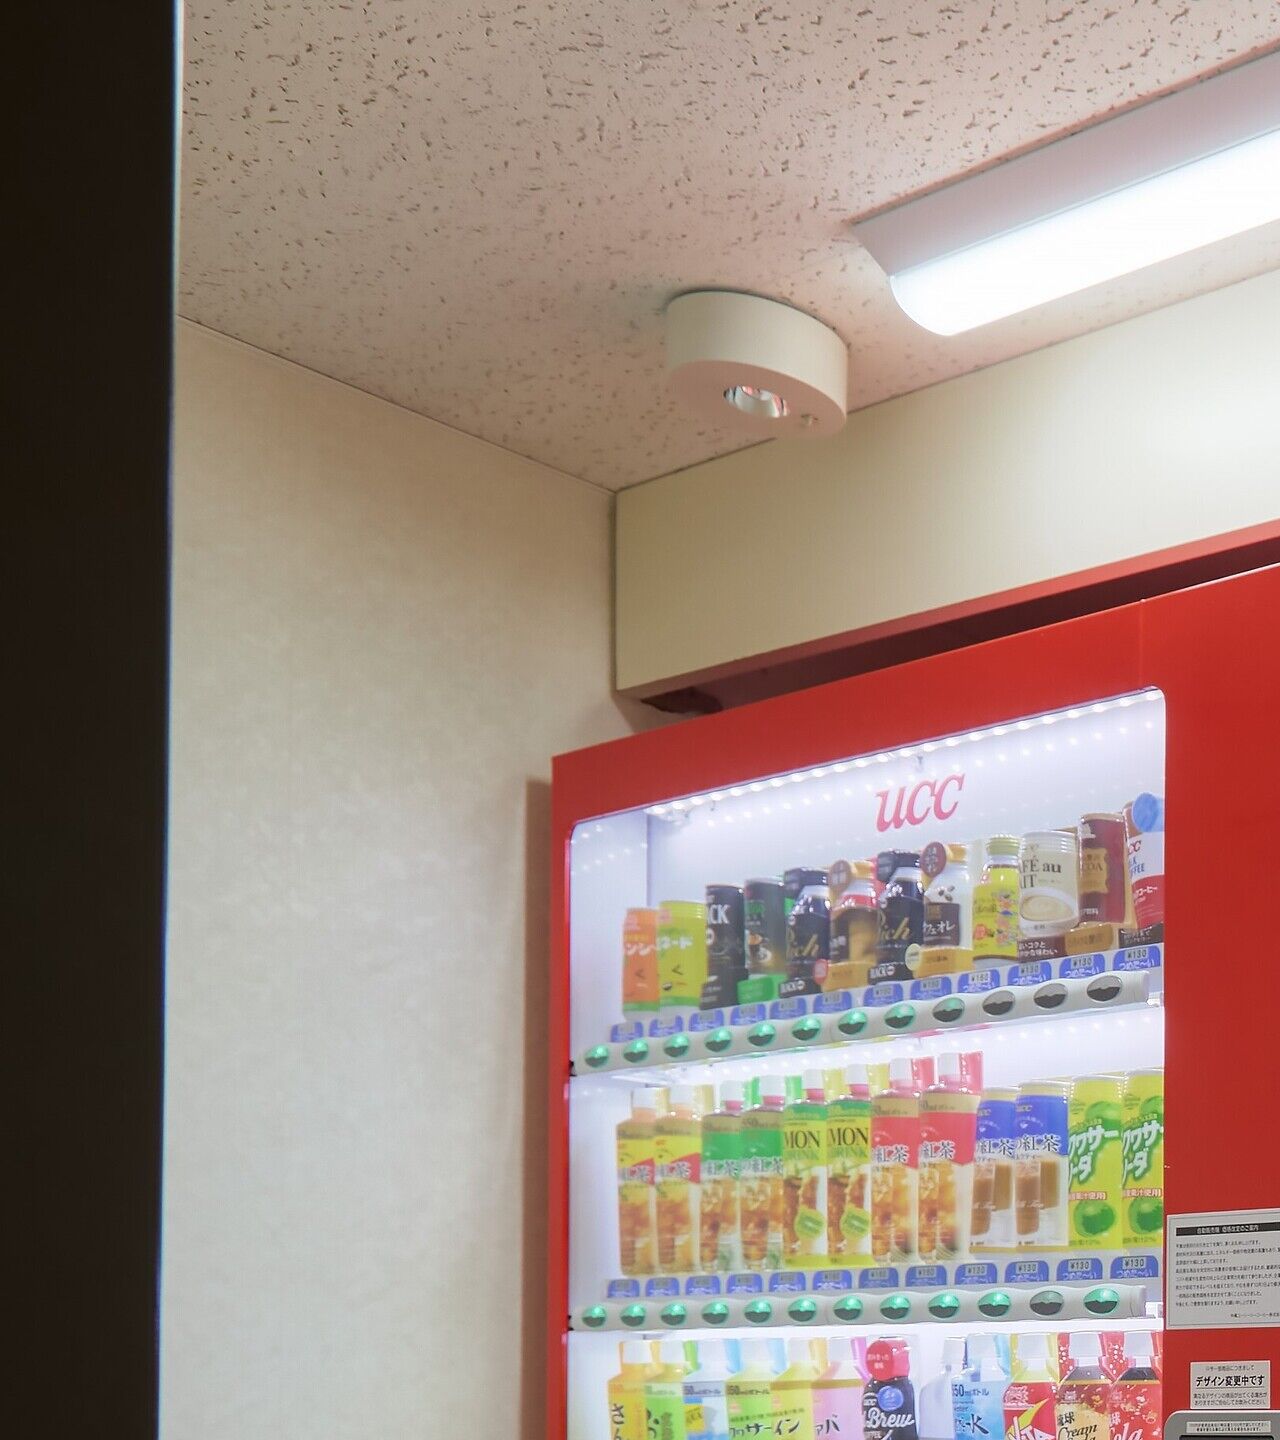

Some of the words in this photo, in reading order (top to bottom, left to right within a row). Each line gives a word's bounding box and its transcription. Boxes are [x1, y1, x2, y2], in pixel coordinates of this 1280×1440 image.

[1196, 1375, 1265, 1387] デザイン変更中です
[868, 1410, 914, 1429] Brew
